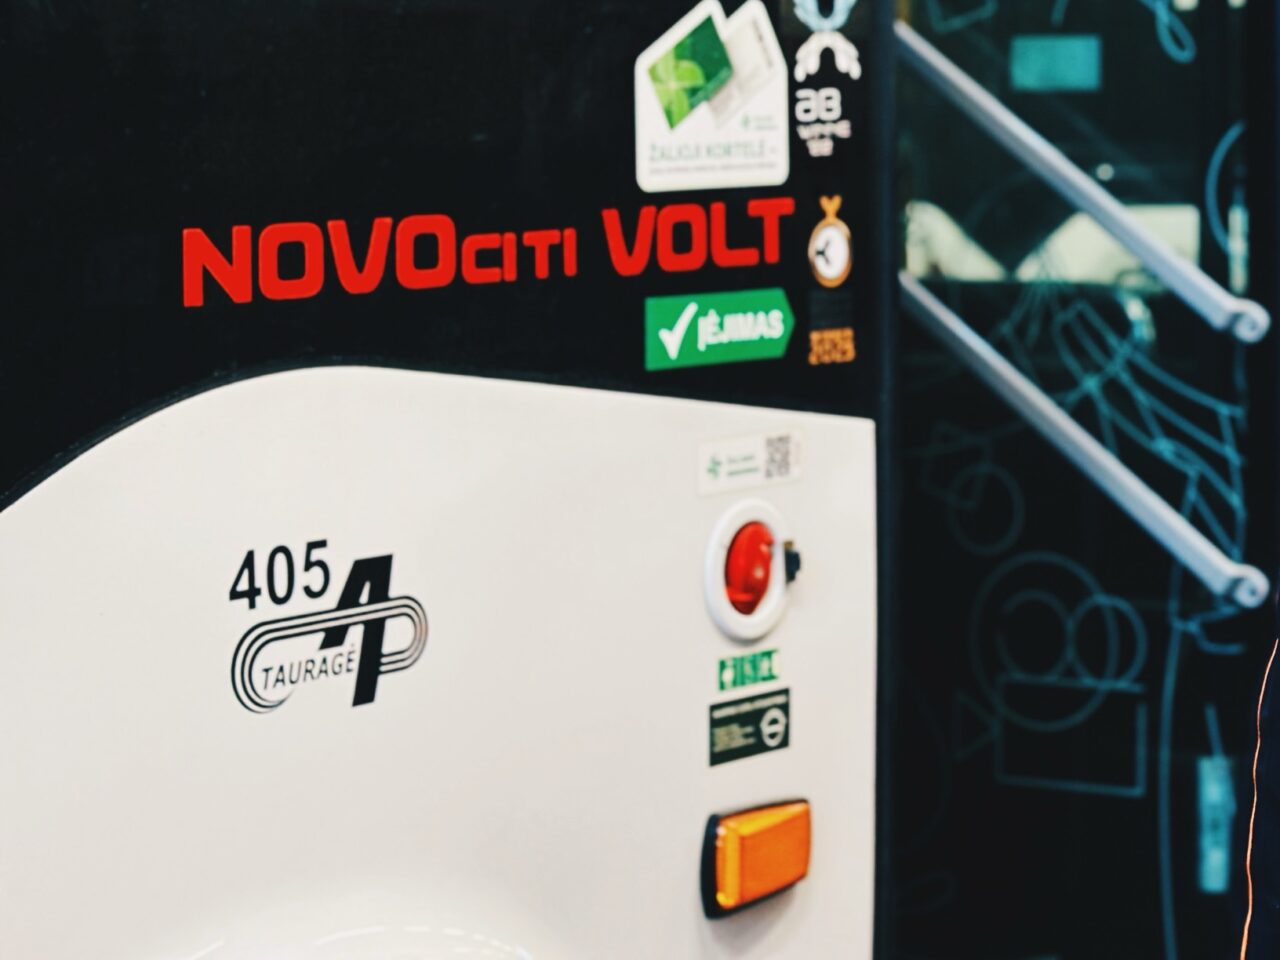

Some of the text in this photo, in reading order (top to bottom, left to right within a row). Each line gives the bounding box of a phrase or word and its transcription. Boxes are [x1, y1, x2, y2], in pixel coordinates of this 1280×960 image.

[602, 197, 796, 277] VOLT
[229, 538, 330, 610] 405
[262, 642, 358, 691] TAURAGĖ
